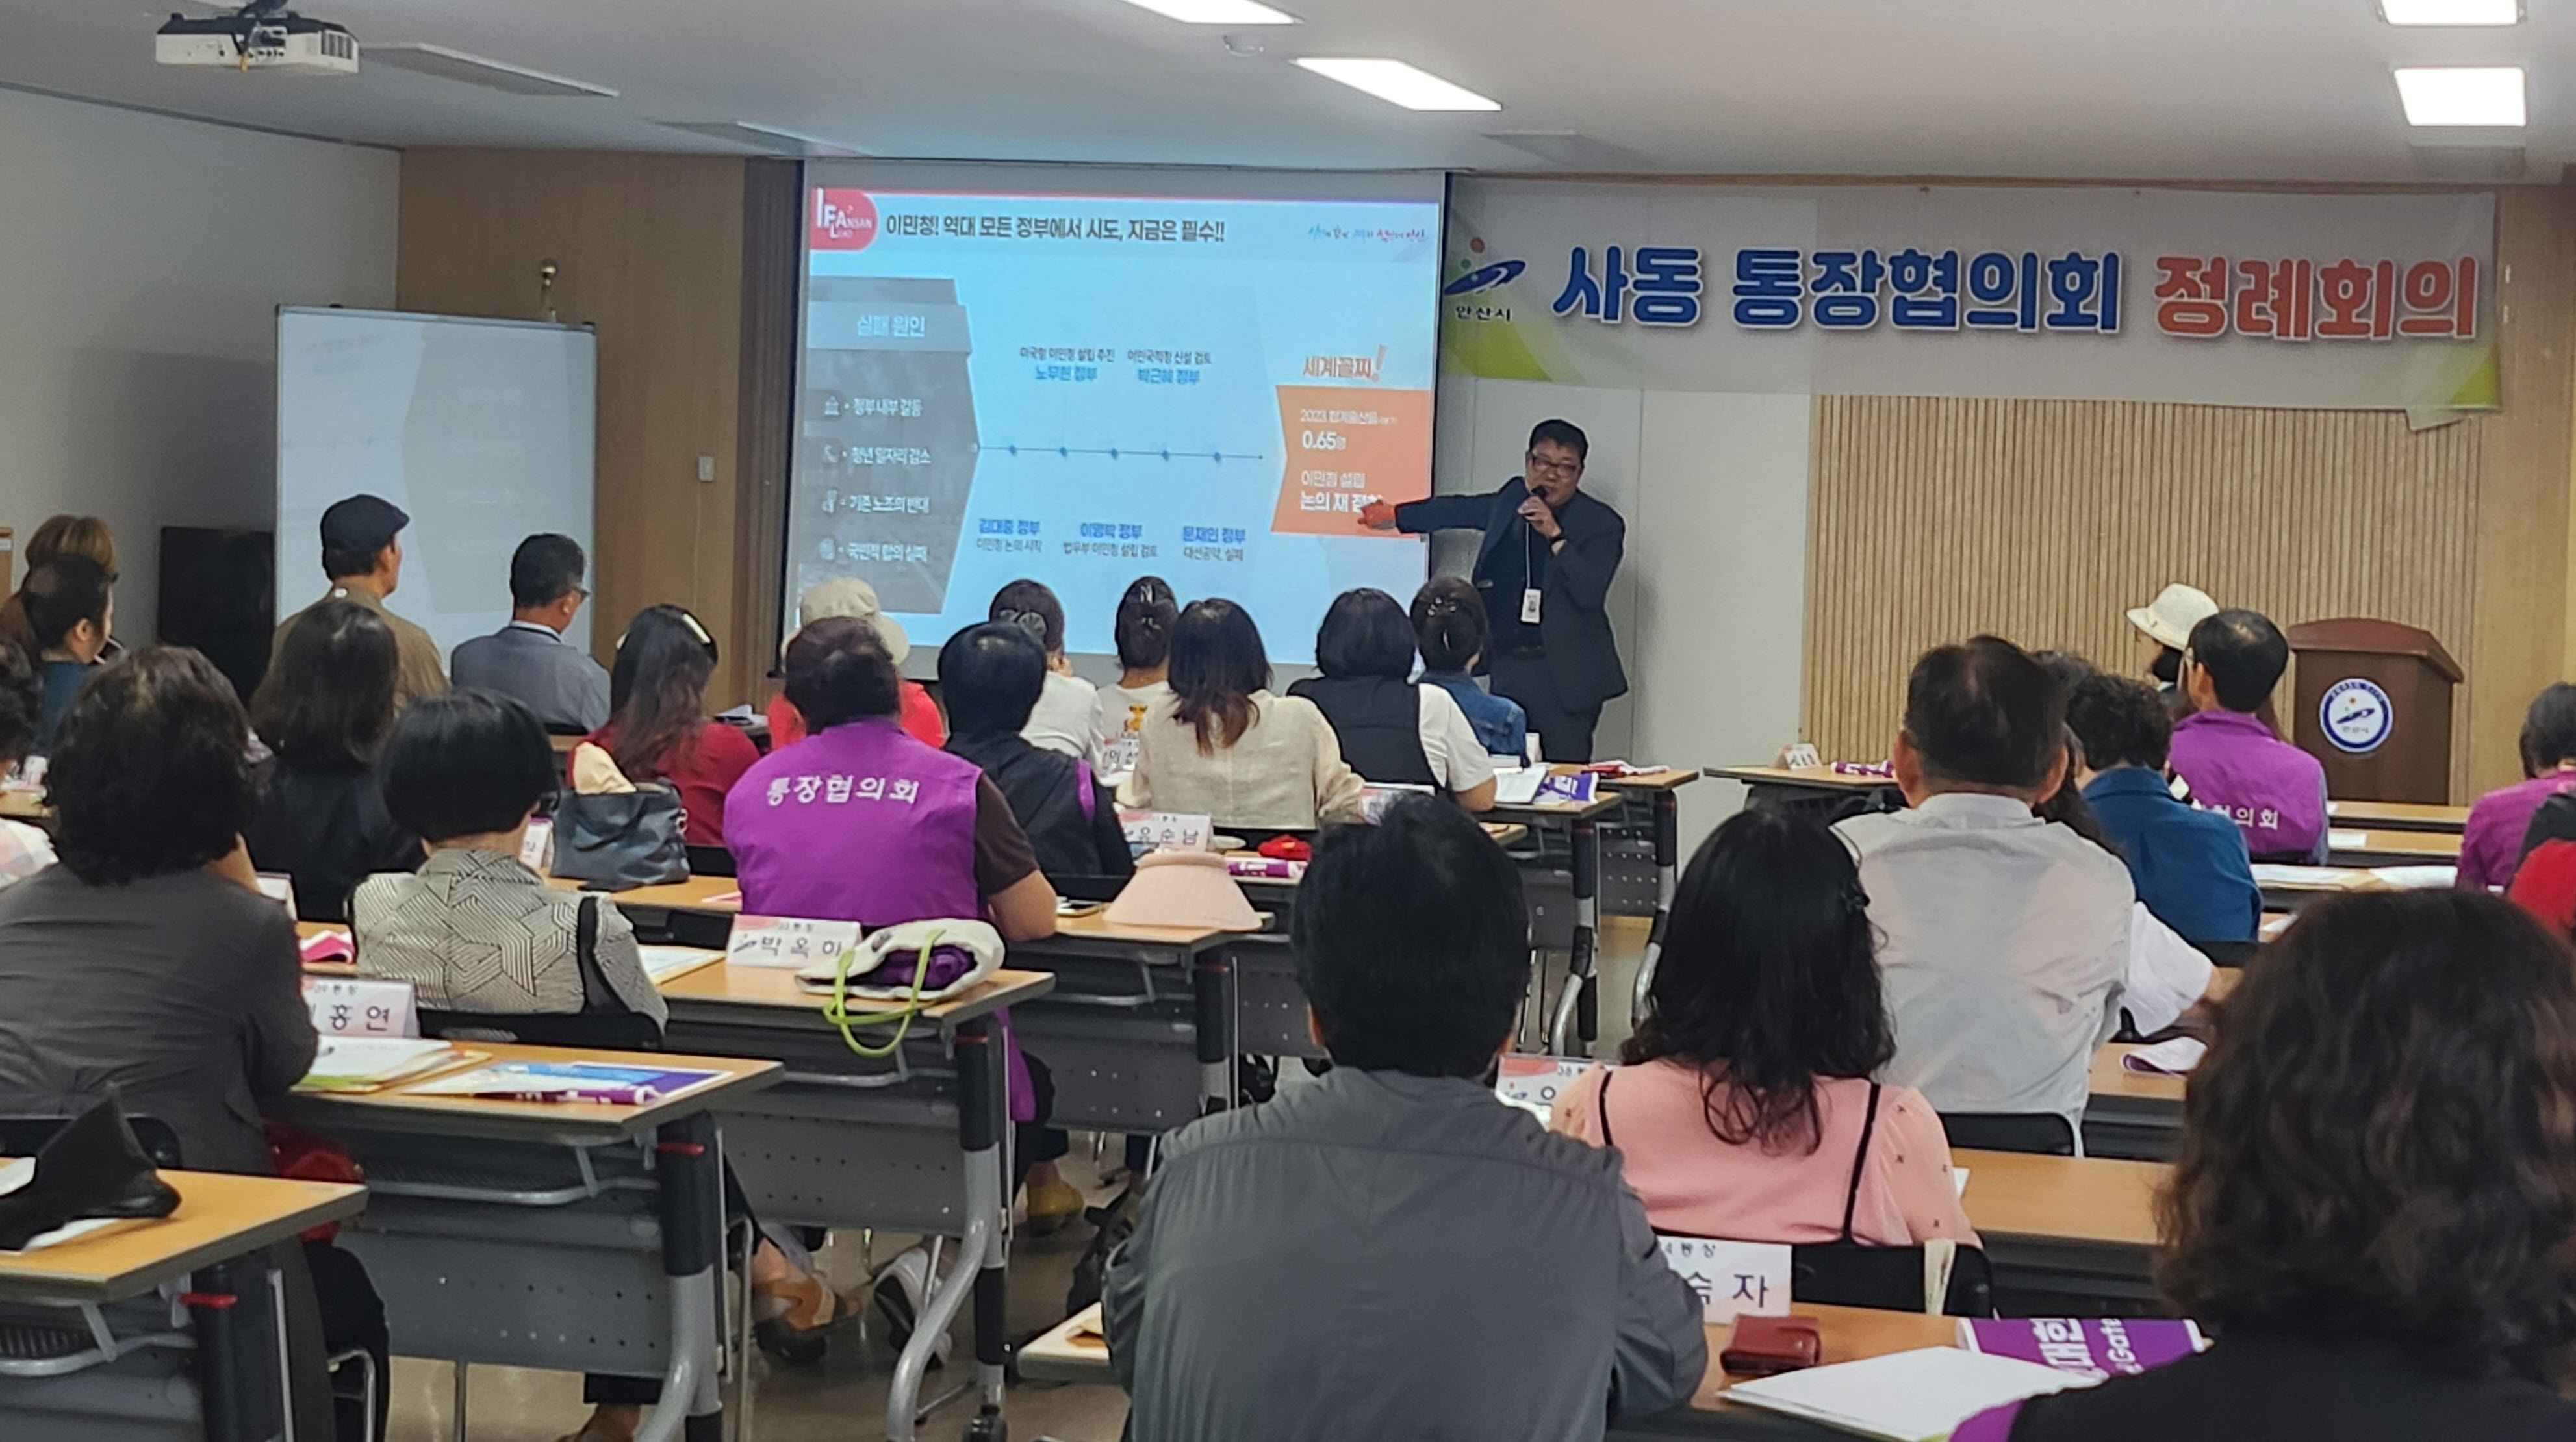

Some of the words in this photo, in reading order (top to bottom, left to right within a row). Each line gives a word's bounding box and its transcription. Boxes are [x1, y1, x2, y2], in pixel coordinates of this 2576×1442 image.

[887, 214, 939, 236] 이민청!
[944, 216, 976, 237] 역대
[979, 216, 1012, 238] 모든
[1017, 216, 1082, 240] 정부에서
[1086, 218, 1123, 241] 시도,
[1128, 219, 1177, 242] 지금은
[1182, 220, 1225, 242] 필수!!
[1553, 246, 1702, 326] 사동
[1733, 247, 2121, 334] 통장협의회
[2153, 255, 2477, 341] 정례회의
[1456, 305, 1511, 322] 안산시
[857, 315, 889, 337] 실패
[893, 315, 925, 337] 원인
[1035, 365, 1071, 381] 노무현
[1074, 366, 1098, 382] 정부
[1138, 368, 1173, 384] 박근혜
[1177, 368, 1200, 385] 정부
[1301, 490, 1331, 512] 논의
[1333, 492, 1349, 512] 재
[979, 519, 1014, 535] 김대중
[1017, 520, 1041, 536] 정부
[1080, 522, 1117, 539] 이명박
[1119, 524, 1143, 540] 정부
[1183, 526, 1219, 543] 문재인
[1222, 528, 1247, 545] 정부
[767, 774, 920, 806] 통장협의회
